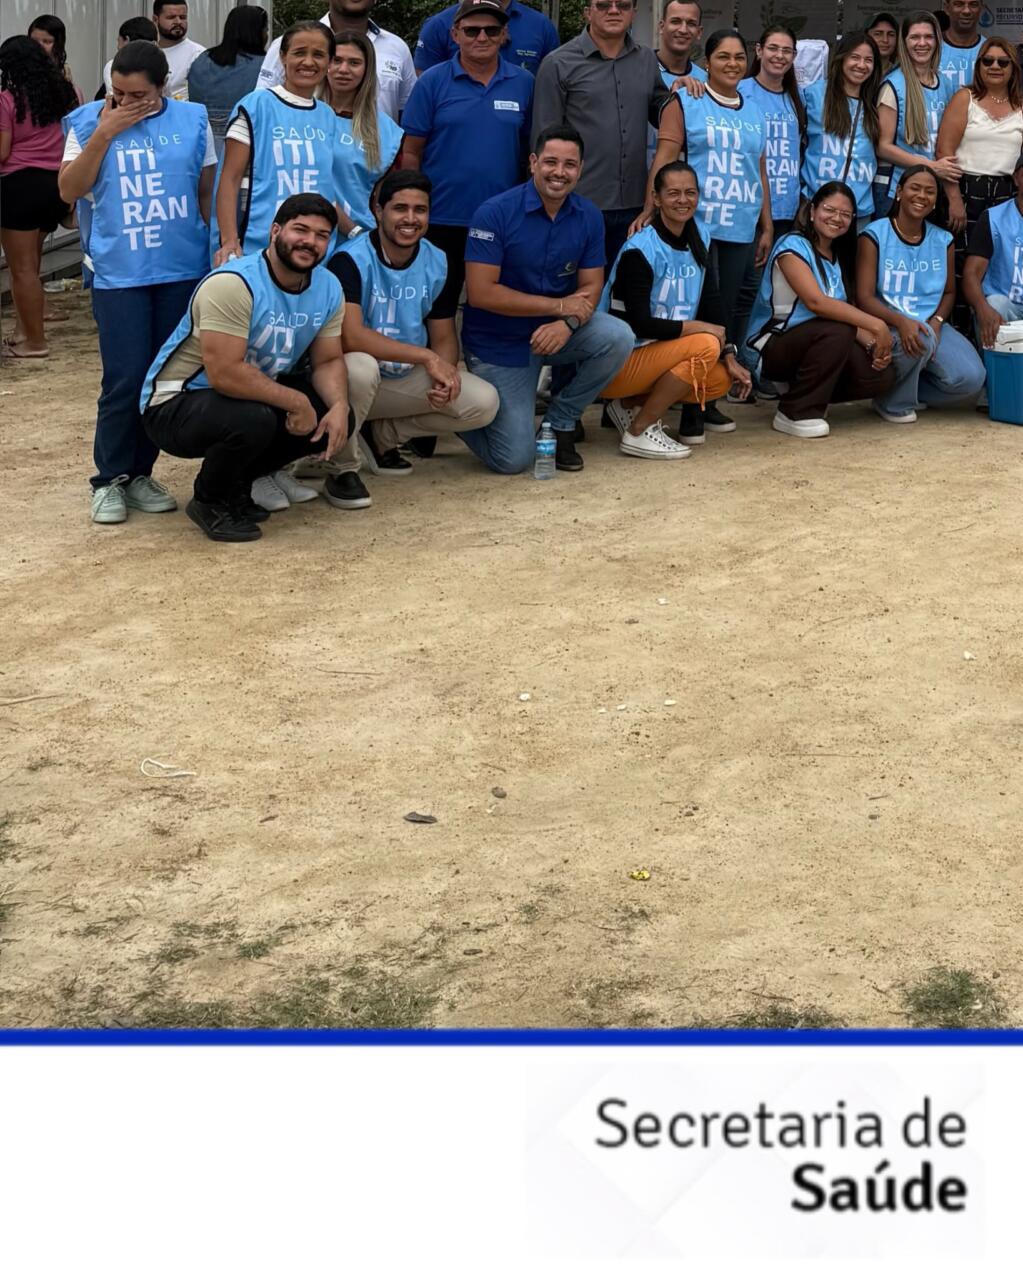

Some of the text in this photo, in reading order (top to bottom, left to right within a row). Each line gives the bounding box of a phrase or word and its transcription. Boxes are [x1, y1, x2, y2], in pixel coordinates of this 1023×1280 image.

[115, 134, 182, 150] SAÚDE
[706, 125, 741, 150] ITI
[766, 121, 788, 138] ITI
[116, 148, 156, 173] ITI
[272, 139, 315, 166] ITI
[766, 140, 790, 157] NE
[707, 150, 745, 176] NE
[765, 159, 799, 177] RAN
[120, 172, 165, 199] NE
[277, 168, 320, 196] NE
[704, 176, 759, 204] RAN
[122, 195, 188, 225] RAN
[701, 201, 736, 227] TE
[122, 225, 162, 251] TE
[884, 258, 941, 272] SAÚDE
[883, 270, 915, 293] ITI
